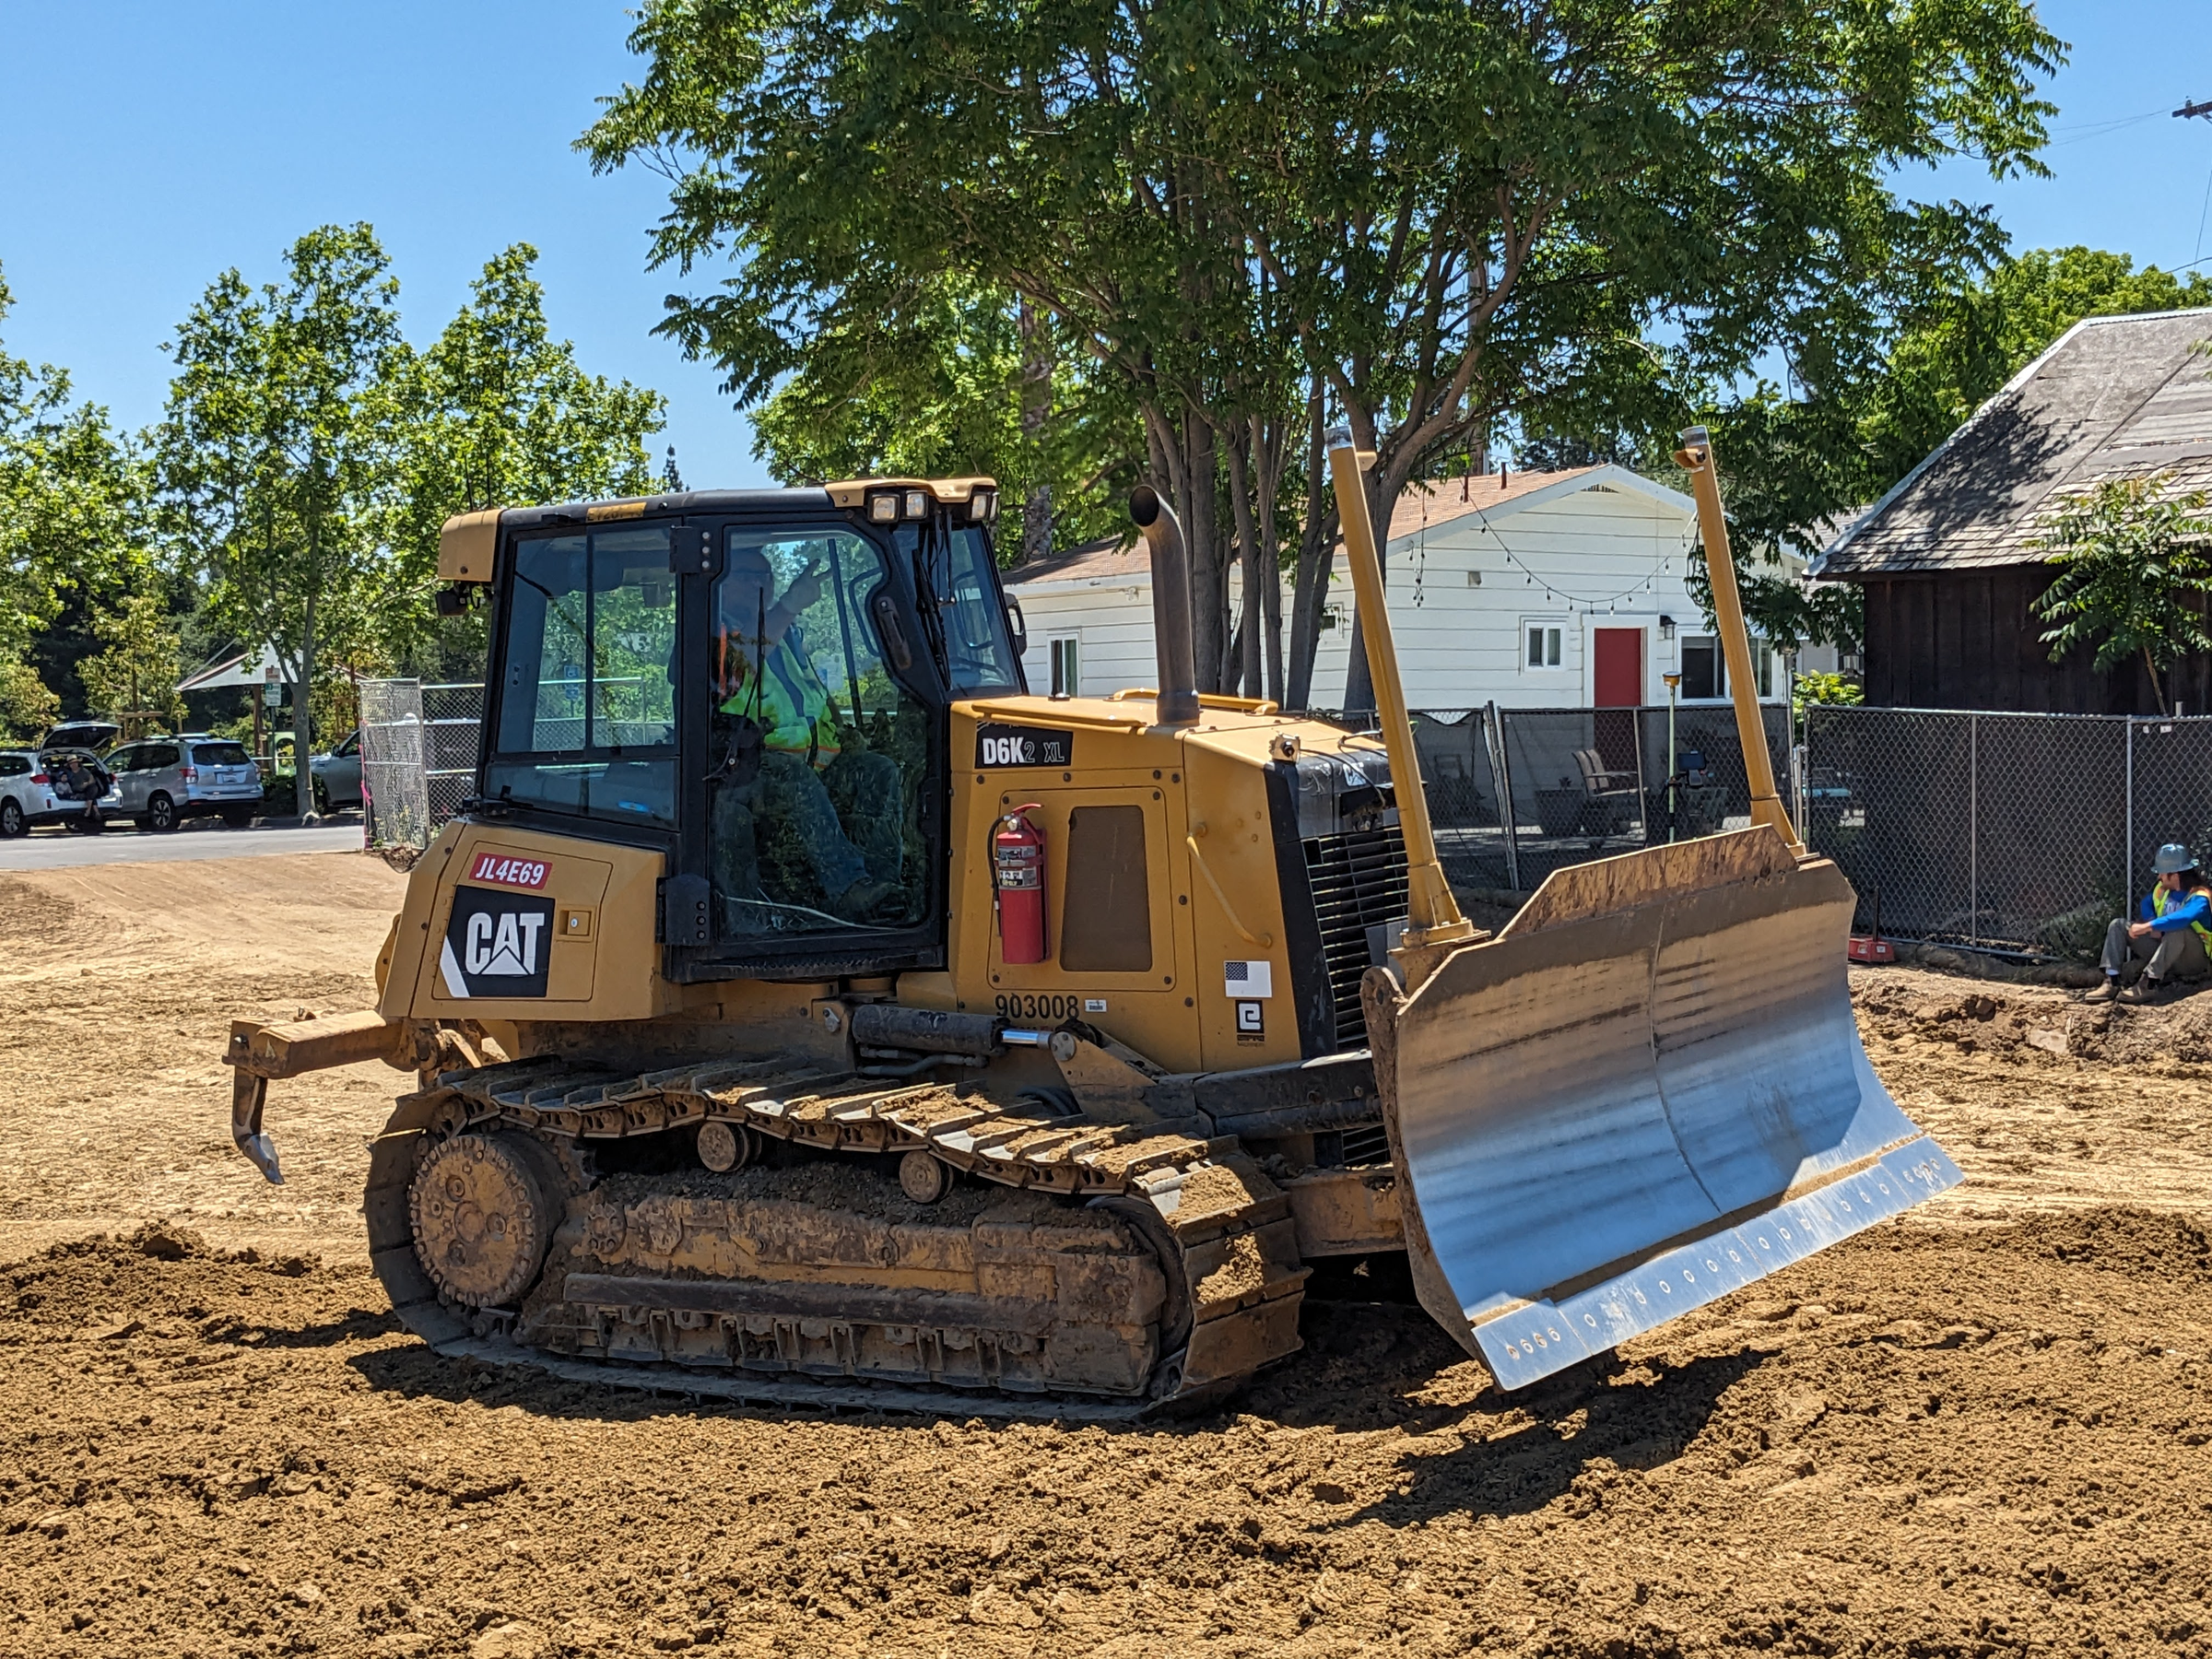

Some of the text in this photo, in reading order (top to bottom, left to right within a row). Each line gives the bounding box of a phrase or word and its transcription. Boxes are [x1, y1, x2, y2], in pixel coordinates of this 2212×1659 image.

[982, 736, 1065, 764] D6K2 XL
[476, 857, 545, 886] JL4E69
[465, 912, 545, 975] CAT
[995, 994, 1079, 1019] 903008
